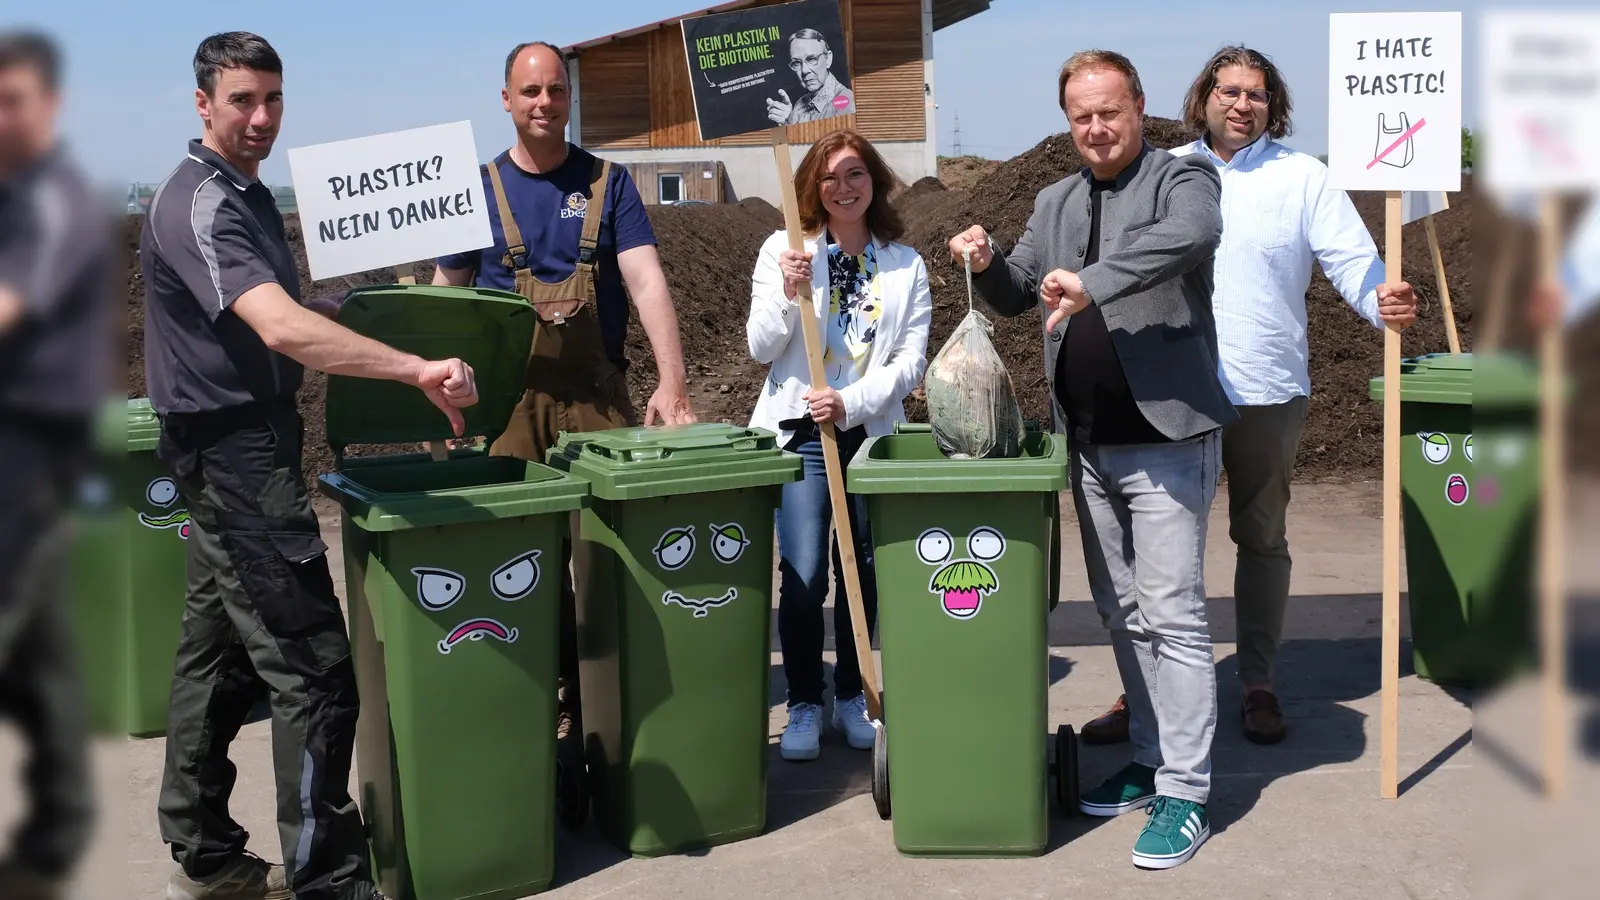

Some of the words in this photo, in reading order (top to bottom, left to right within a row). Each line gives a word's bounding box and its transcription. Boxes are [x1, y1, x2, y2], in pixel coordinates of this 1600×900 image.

[696, 35, 722, 53] KEIN
[723, 28, 766, 49] PLASTIK
[768, 25, 780, 41] IN
[1357, 40, 1368, 60] I
[1375, 37, 1433, 59] HATE
[699, 53, 718, 70] DIE
[718, 44, 774, 67] BIOTONNE.
[1345, 70, 1445, 96] PLASTIC!
[328, 155, 443, 200] PLASTIK?
[318, 210, 380, 243] NEIN
[387, 188, 475, 230] DANKE!
